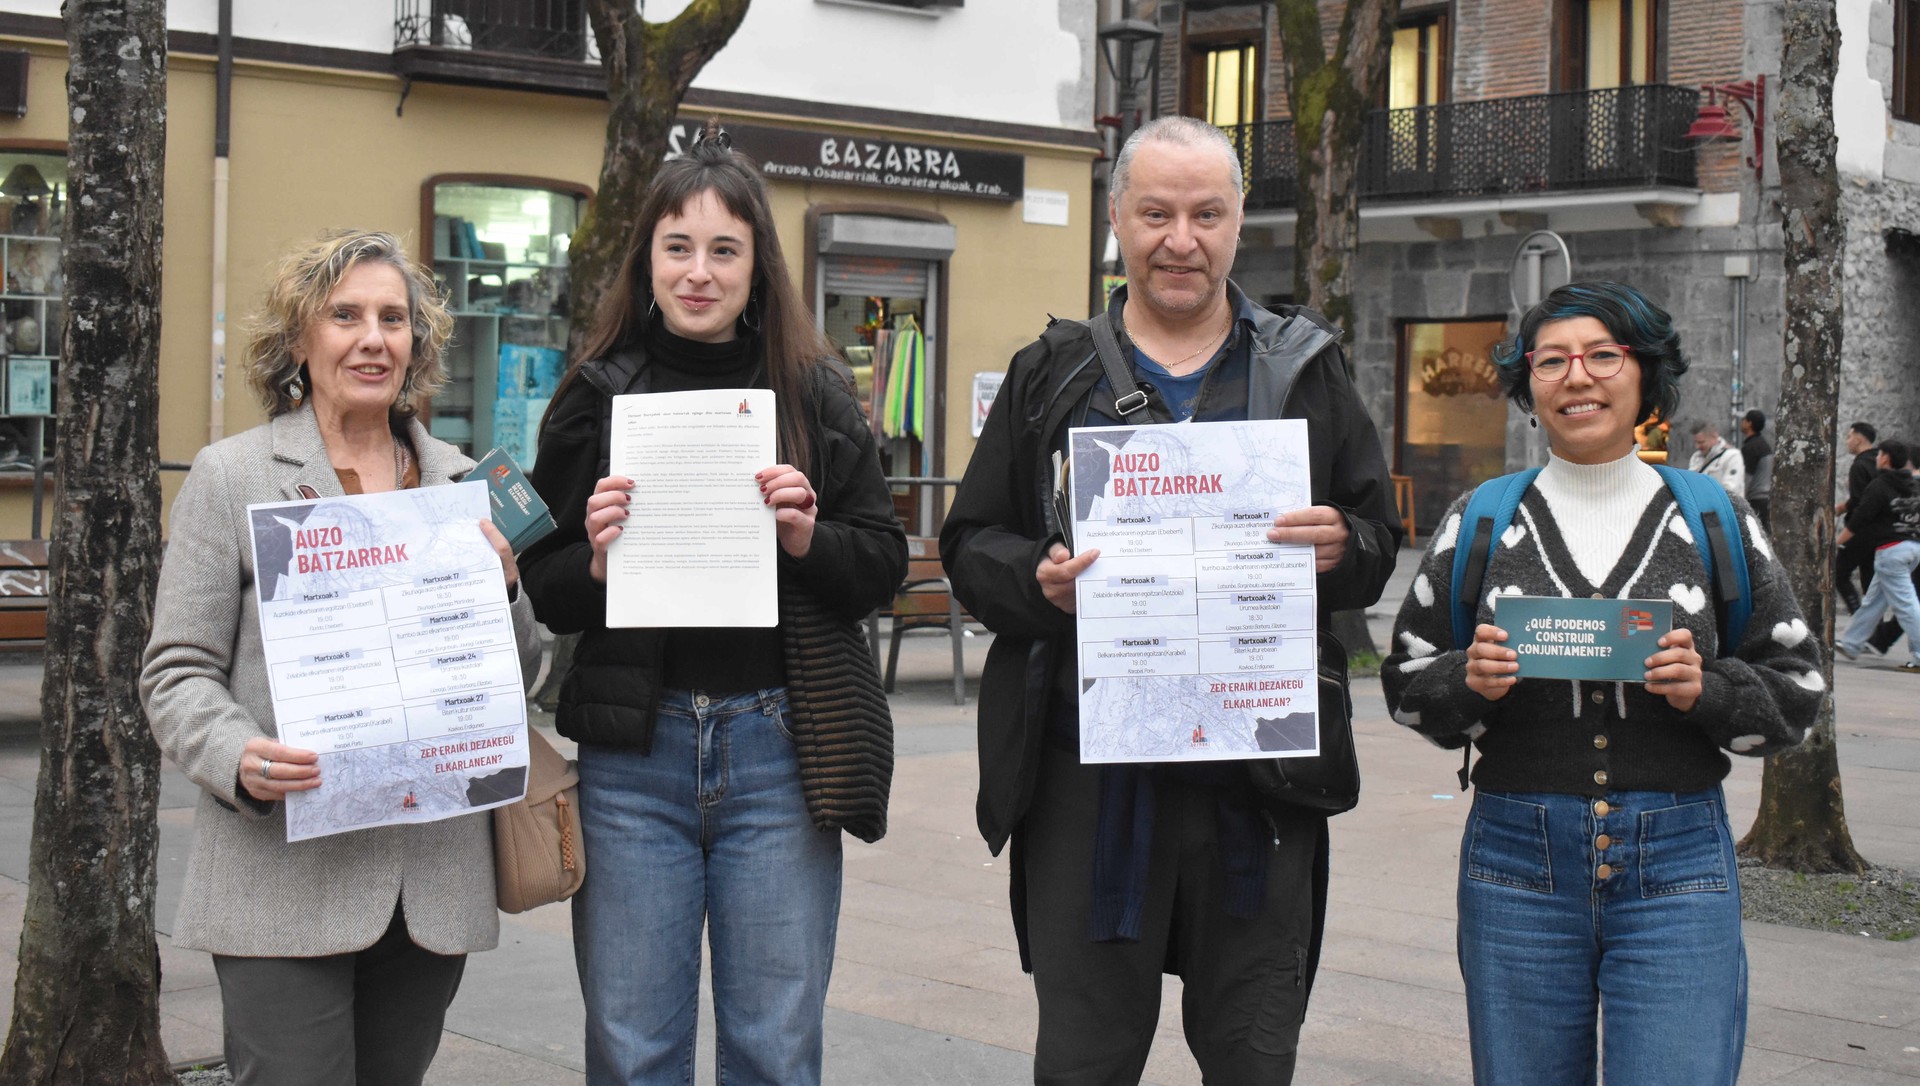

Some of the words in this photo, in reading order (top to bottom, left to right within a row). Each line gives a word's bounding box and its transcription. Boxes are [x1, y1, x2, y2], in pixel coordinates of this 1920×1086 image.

[821, 138, 960, 178] BAZARRA
[764, 161, 811, 178] Arropa,
[813, 166, 882, 185] Osagarriak,
[1112, 452, 1160, 473] AUZO
[1113, 474, 1223, 497] BATZARRAK
[295, 526, 343, 550] AUZO
[297, 543, 409, 574] BATZARRAK
[423, 574, 452, 584] Martxoak
[304, 592, 334, 601] Martxoak
[430, 614, 459, 623] Martxoak
[1525, 616, 1552, 632] ¿QUÉ
[1555, 619, 1606, 631] PODEMOS
[1535, 632, 1595, 643] CONSTRUIR
[1517, 643, 1612, 657] CONJUNTAMENTE?
[315, 653, 344, 662] Martxoak
[438, 655, 467, 664] Martxoak
[1210, 683, 1226, 693] ZER
[1229, 682, 1257, 692] ERAIKI
[1259, 680, 1303, 690] DEZAKEGU
[445, 696, 475, 706] Martxoak
[1223, 697, 1291, 709] ELKARLANEAN?
[325, 712, 355, 721] Martxoak
[421, 748, 437, 759] ZER
[440, 742, 468, 756] ERAIKI
[471, 735, 515, 751] DEZAKEGU
[435, 753, 503, 774] ELKARLANEAN?
